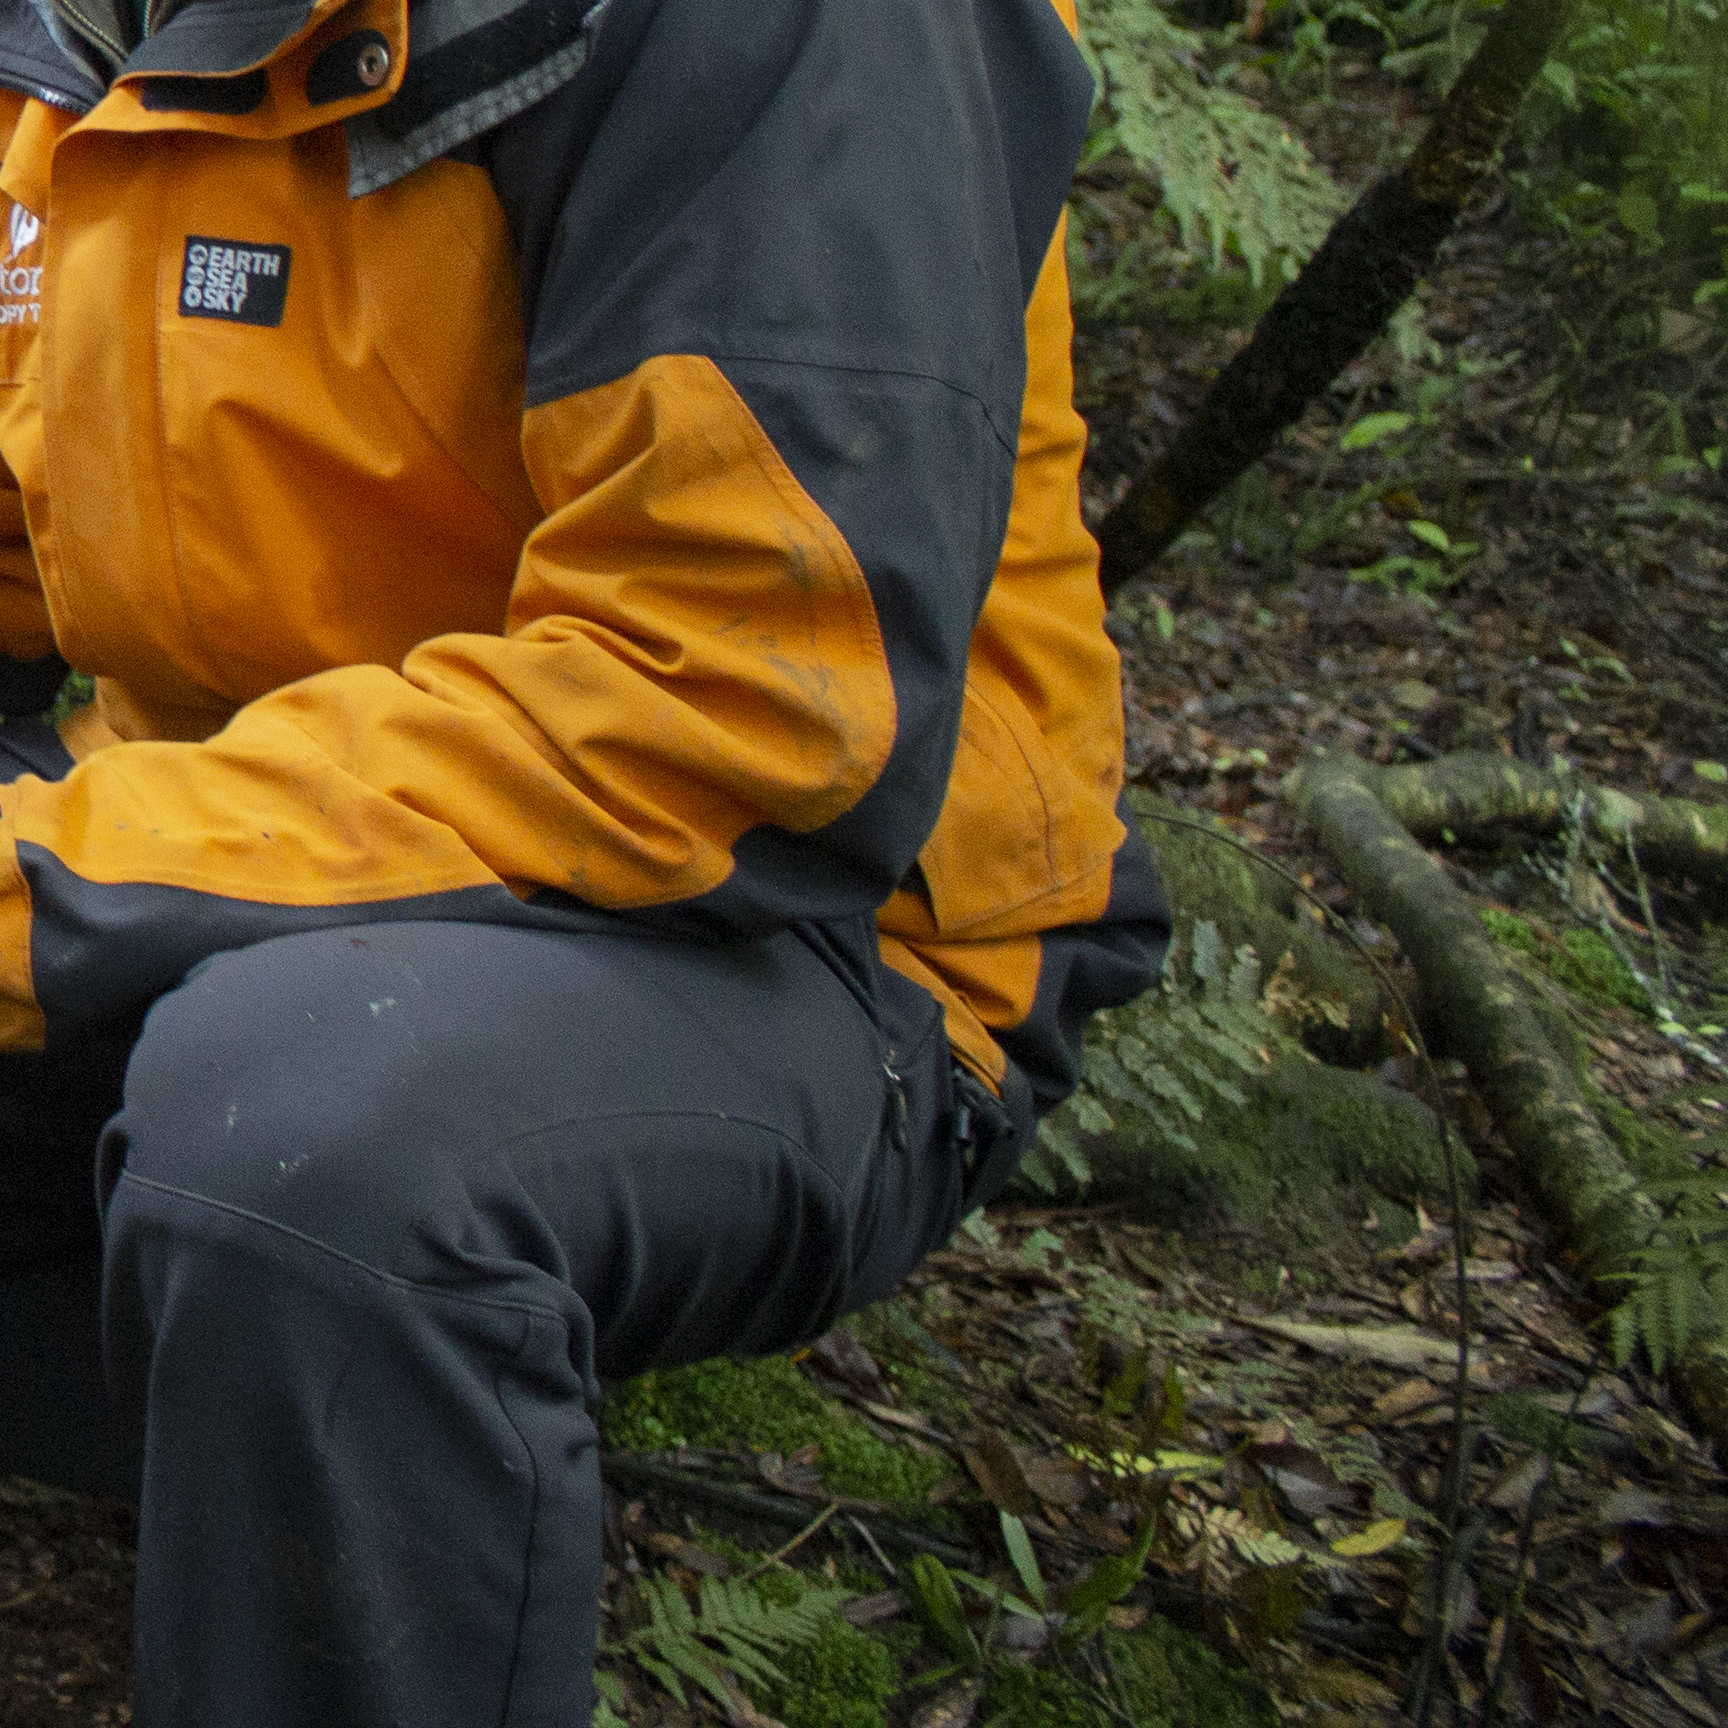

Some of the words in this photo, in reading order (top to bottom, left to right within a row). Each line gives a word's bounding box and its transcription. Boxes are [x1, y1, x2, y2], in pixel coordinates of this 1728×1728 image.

[209, 245, 282, 276] EARTH
[205, 266, 249, 294] SEA
[28, 302, 42, 324] T
[203, 286, 248, 314] SKY
